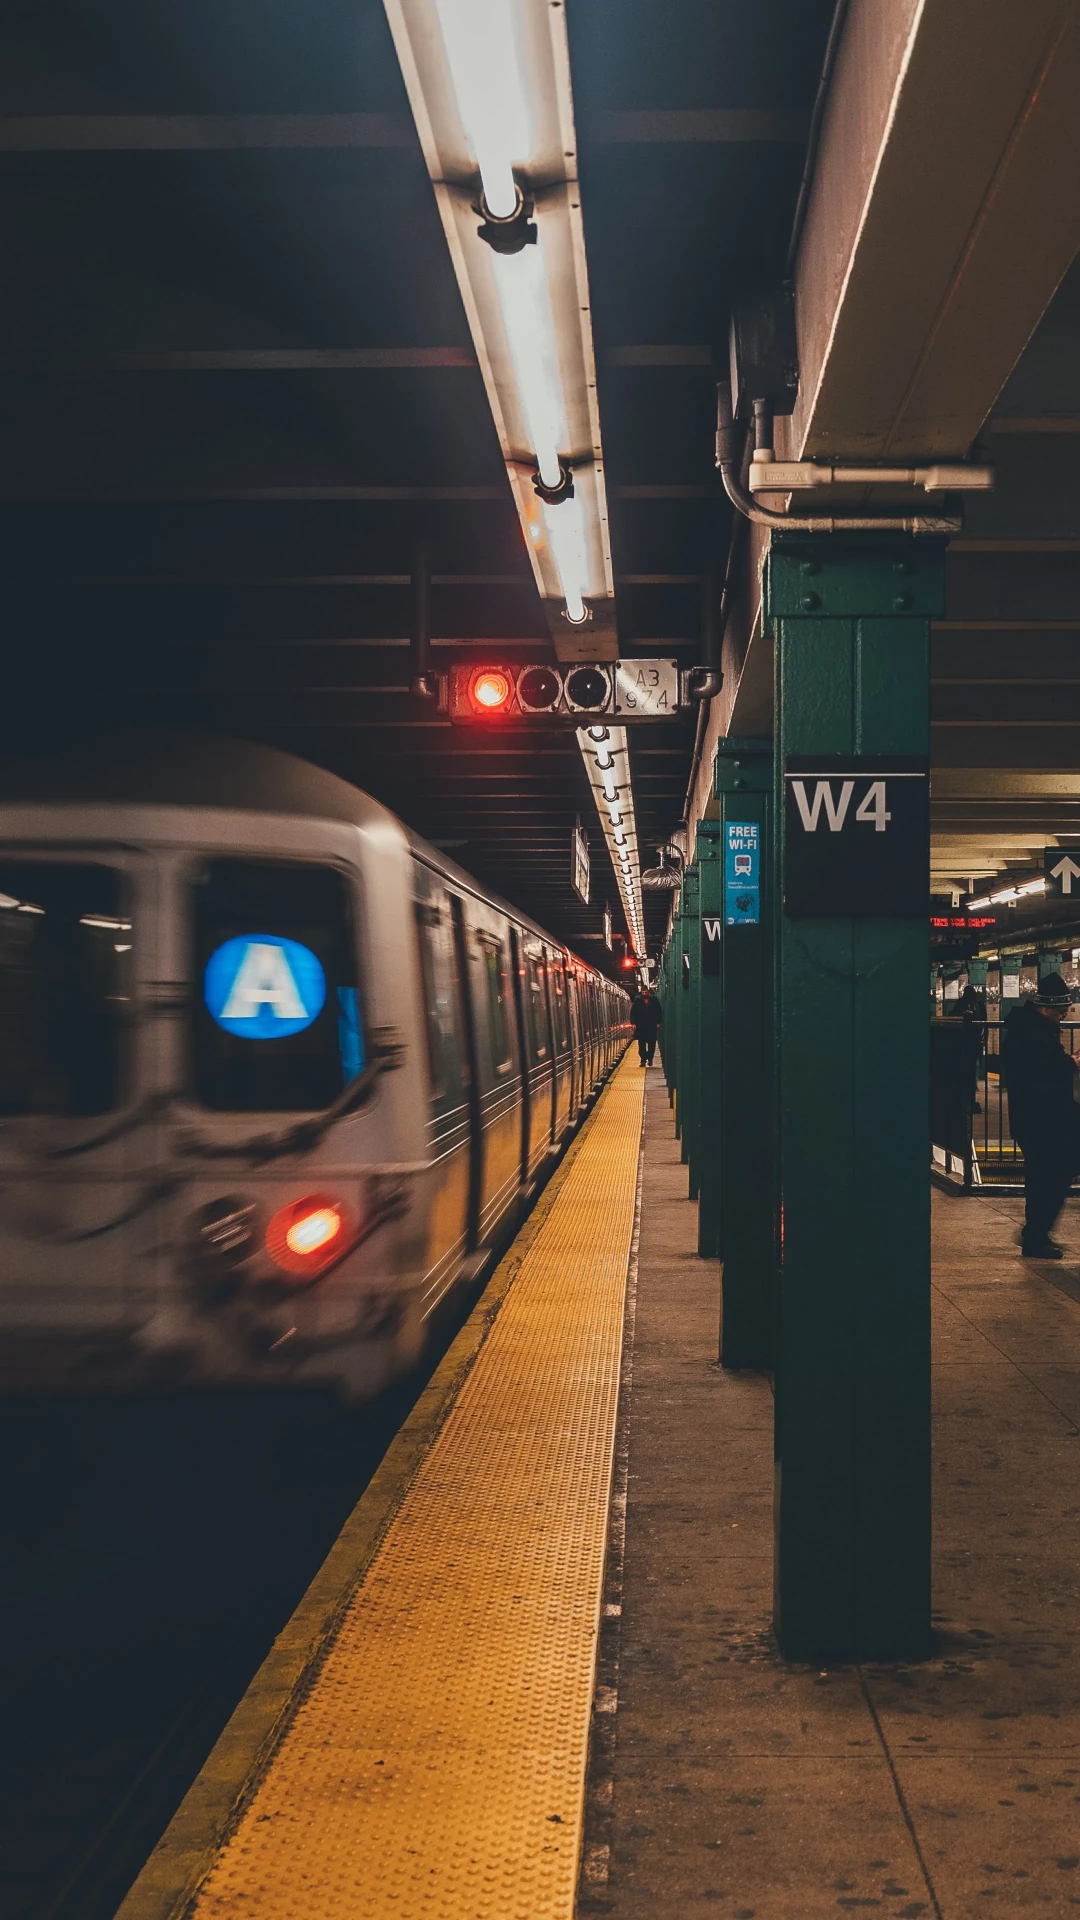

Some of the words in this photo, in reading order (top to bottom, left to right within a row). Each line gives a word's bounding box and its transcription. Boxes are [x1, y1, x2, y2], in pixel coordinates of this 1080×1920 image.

[636, 669, 660, 687] A3
[626, 690, 669, 709] 974
[791, 781, 892, 832] W4
[729, 826, 757, 837] FREE
[728, 839, 757, 850] WI-FI
[704, 921, 720, 941] W
[219, 943, 310, 1018] A
